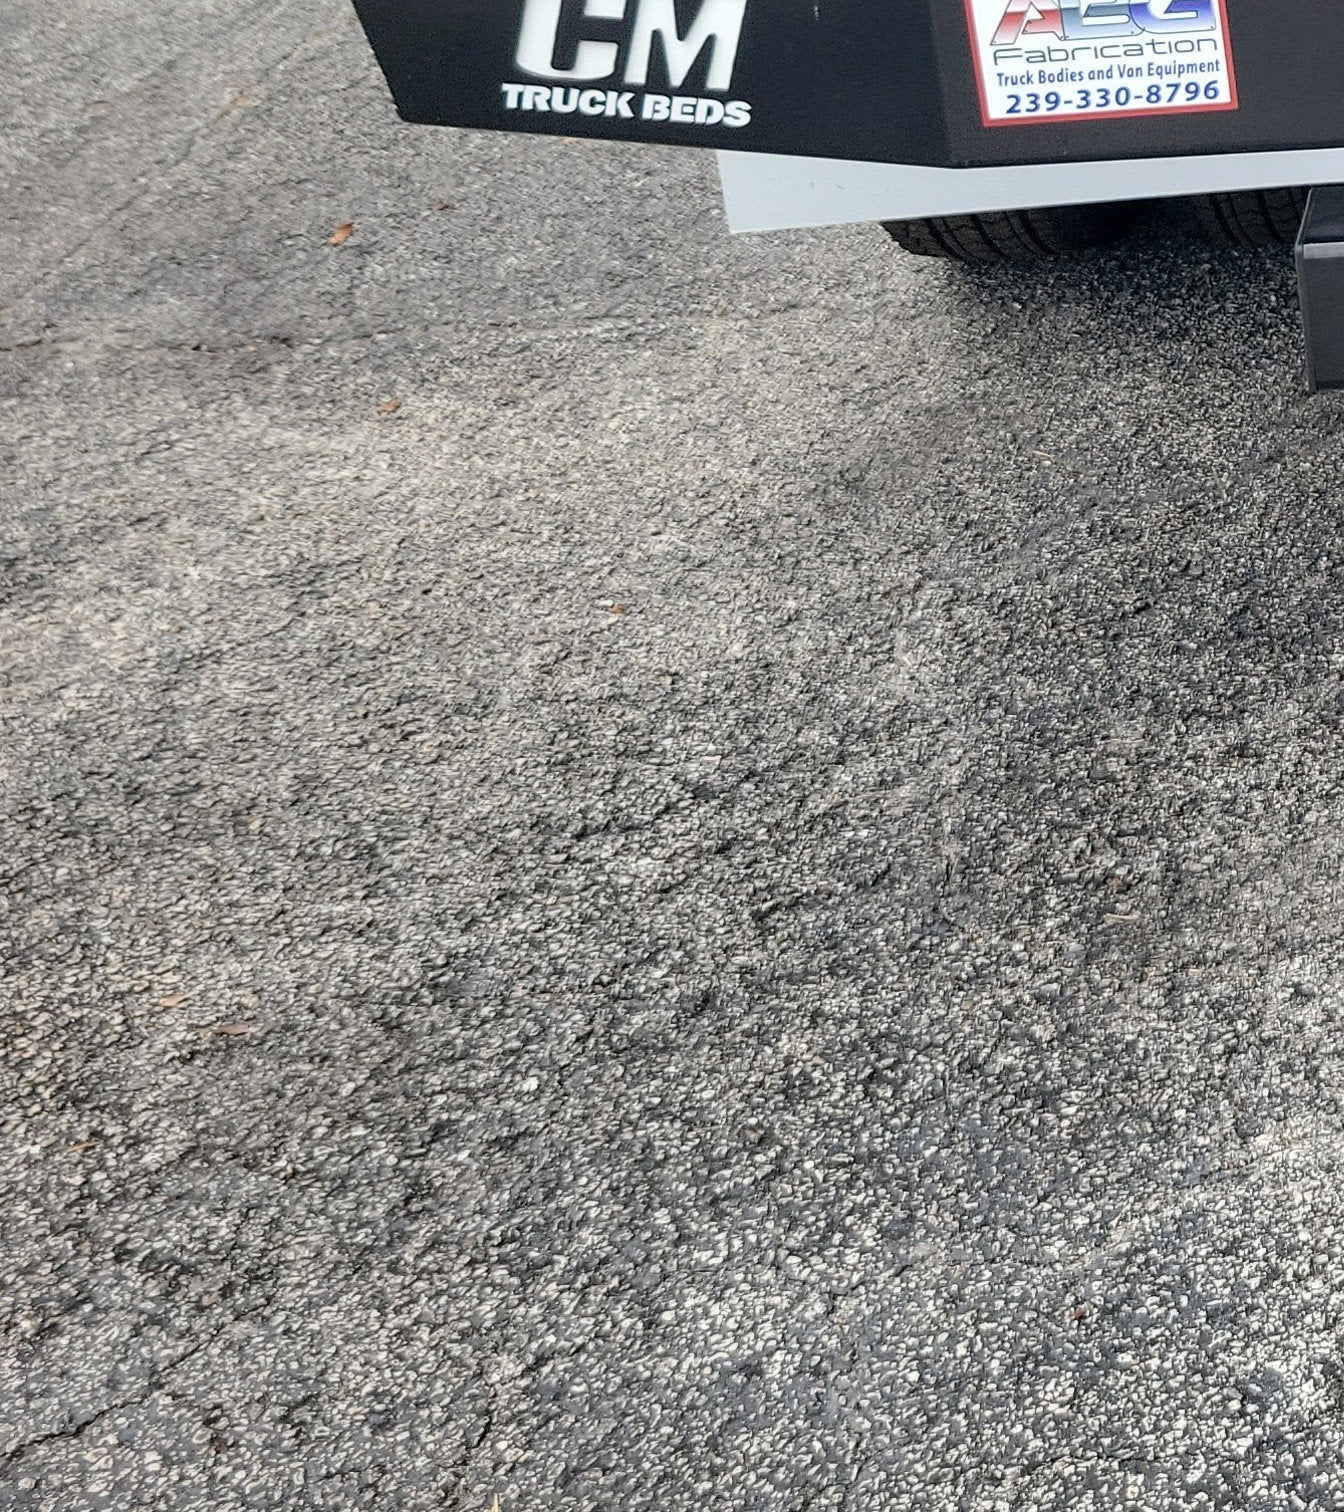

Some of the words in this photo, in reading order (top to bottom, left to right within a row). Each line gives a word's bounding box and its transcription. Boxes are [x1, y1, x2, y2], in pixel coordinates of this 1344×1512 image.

[993, 38, 1218, 66] Fabrication
[997, 71, 1034, 88] Truck
[1038, 67, 1084, 84] Bodies
[1088, 64, 1114, 81] and
[1117, 62, 1144, 79] Van
[1147, 58, 1220, 80] Equipment
[501, 82, 636, 120] TRUCK
[641, 93, 752, 128] BEDS
[1005, 79, 1220, 115] 239-330-8796
